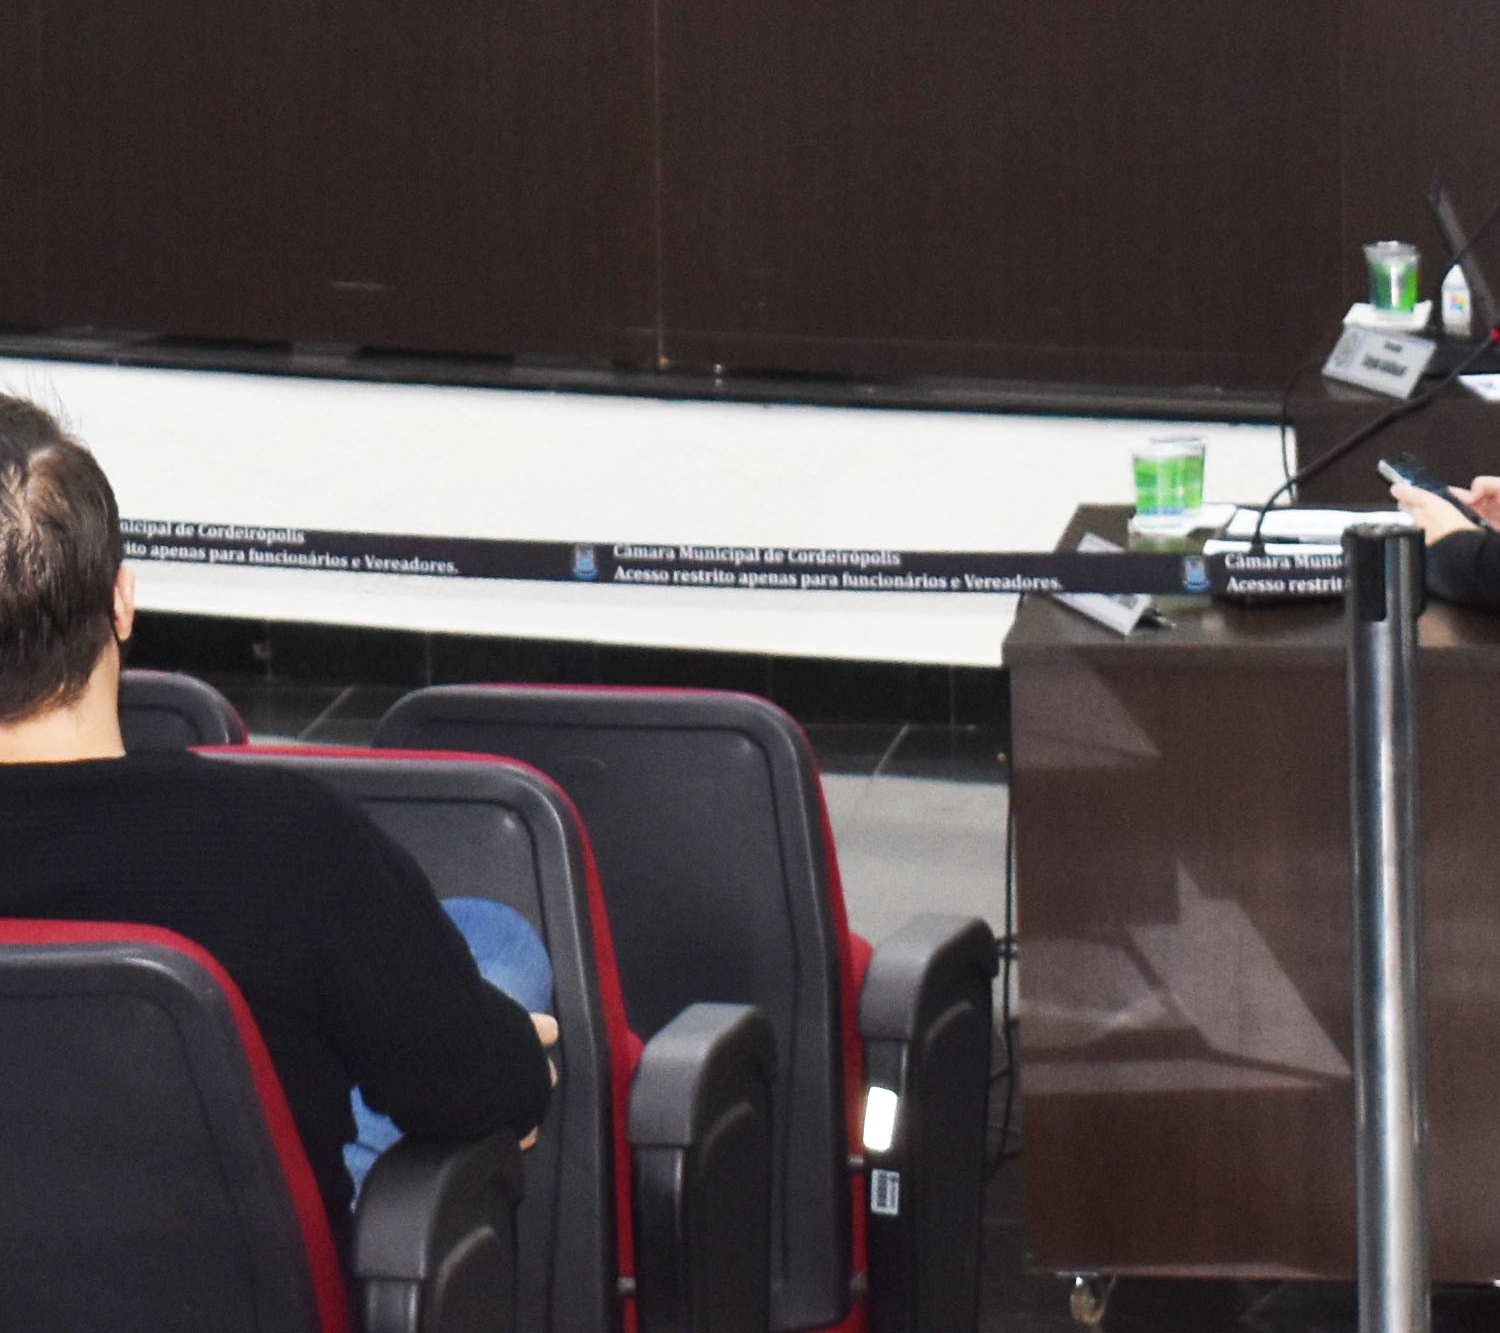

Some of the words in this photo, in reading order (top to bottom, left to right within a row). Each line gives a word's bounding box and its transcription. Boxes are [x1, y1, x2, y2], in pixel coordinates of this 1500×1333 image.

[119, 520, 171, 537] nicipal
[175, 522, 194, 536] de
[151, 544, 206, 560] apenas
[209, 548, 245, 563] para
[249, 548, 348, 567] funcionários
[351, 556, 361, 568] e
[364, 554, 459, 574] Vereadores.
[680, 545, 760, 564] Municipal
[764, 547, 784, 562] de
[614, 565, 669, 582] Acesso
[673, 568, 734, 584] restrito
[738, 572, 797, 588] apenas
[801, 573, 837, 589] para
[842, 572, 947, 589] funcionários
[950, 576, 960, 589] e
[1226, 576, 1285, 593] Acesso
[1288, 576, 1347, 593] restrit
